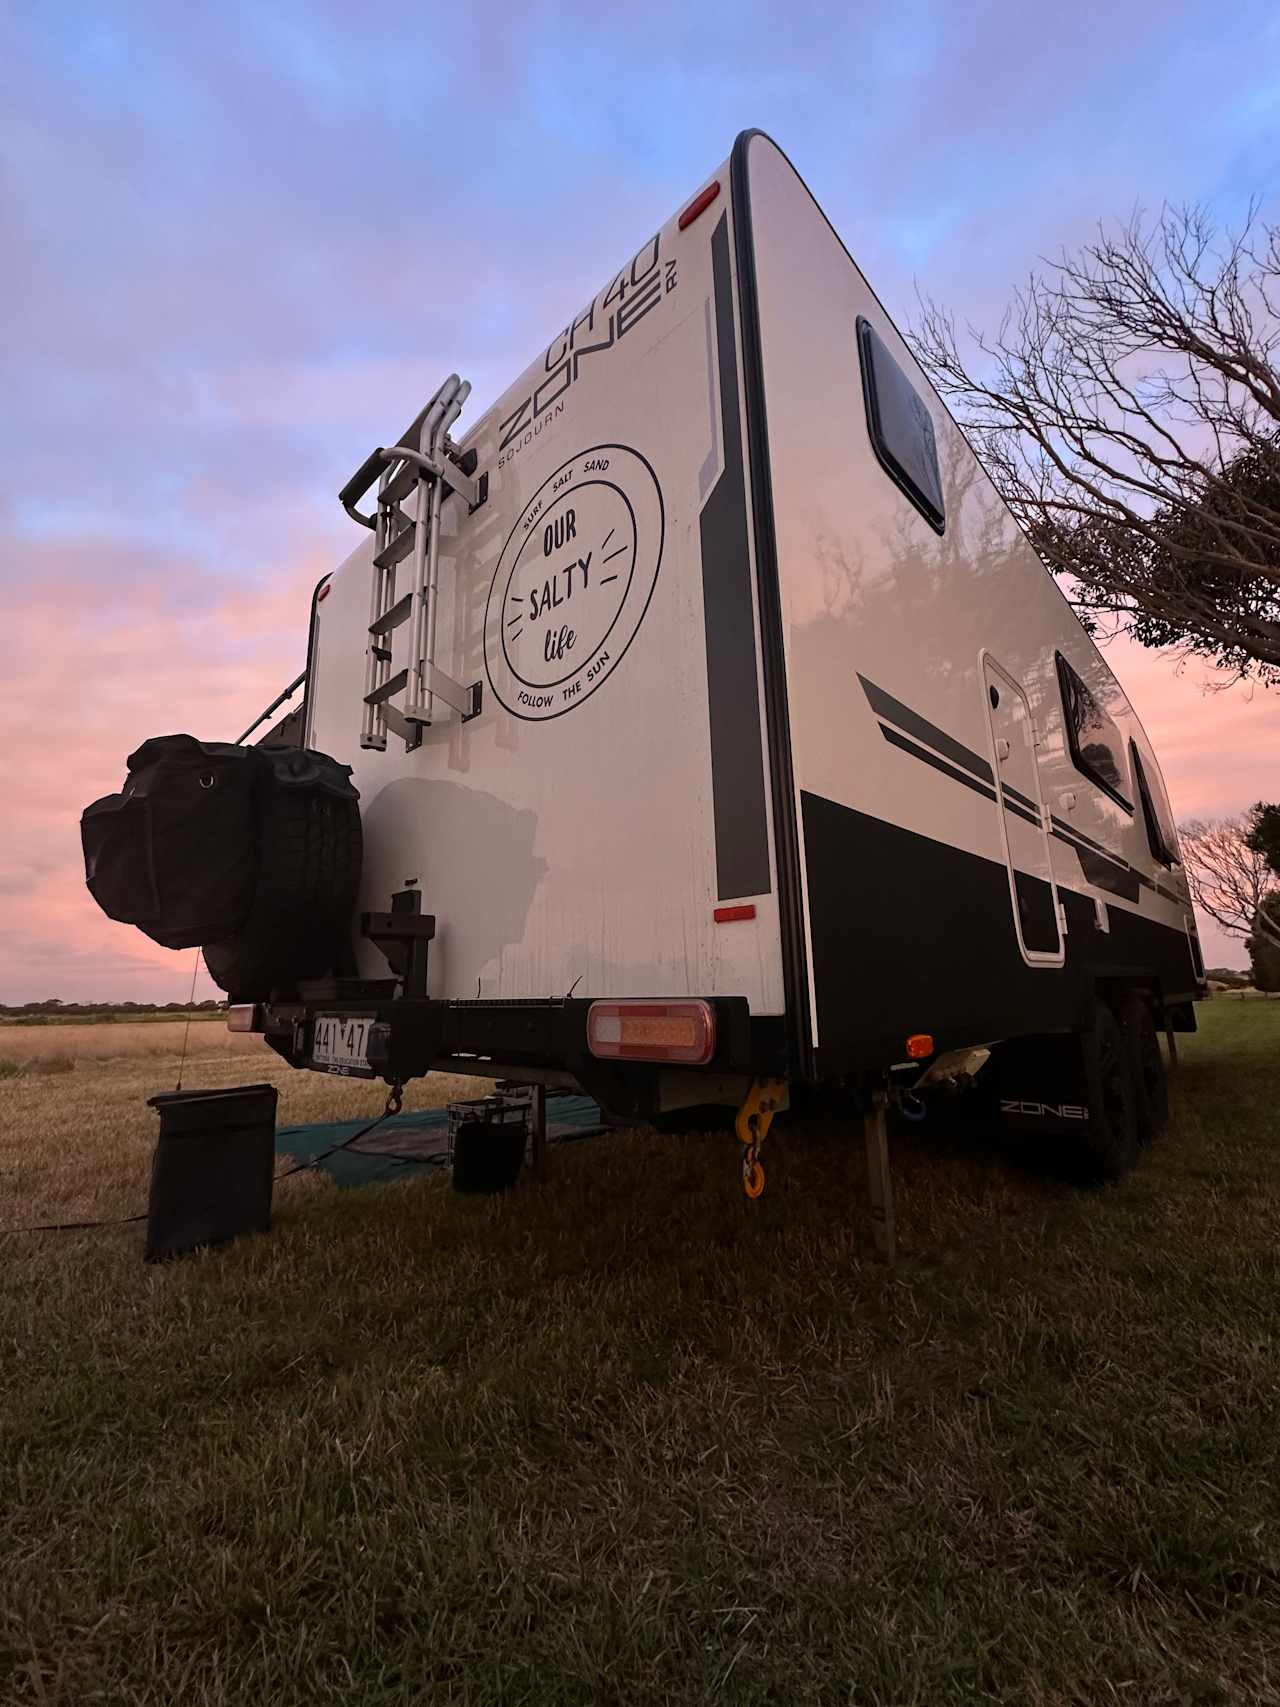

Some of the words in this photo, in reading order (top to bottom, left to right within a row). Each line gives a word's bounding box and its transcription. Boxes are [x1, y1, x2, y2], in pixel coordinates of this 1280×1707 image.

[603, 233, 661, 310] 40
[665, 259, 677, 294] RV
[499, 269, 661, 451] ZONE
[498, 401, 565, 469] SOJOURN
[523, 501, 544, 529] SURF
[552, 470, 573, 492] SALT
[583, 459, 610, 473] SAND
[543, 508, 577, 557] OUR
[530, 551, 592, 620] SALTY
[544, 624, 577, 662] life
[517, 690, 554, 707] FOLLOW
[562, 680, 582, 701] THE
[587, 651, 611, 682] SUN
[1000, 1100, 1083, 1119] ZONE
